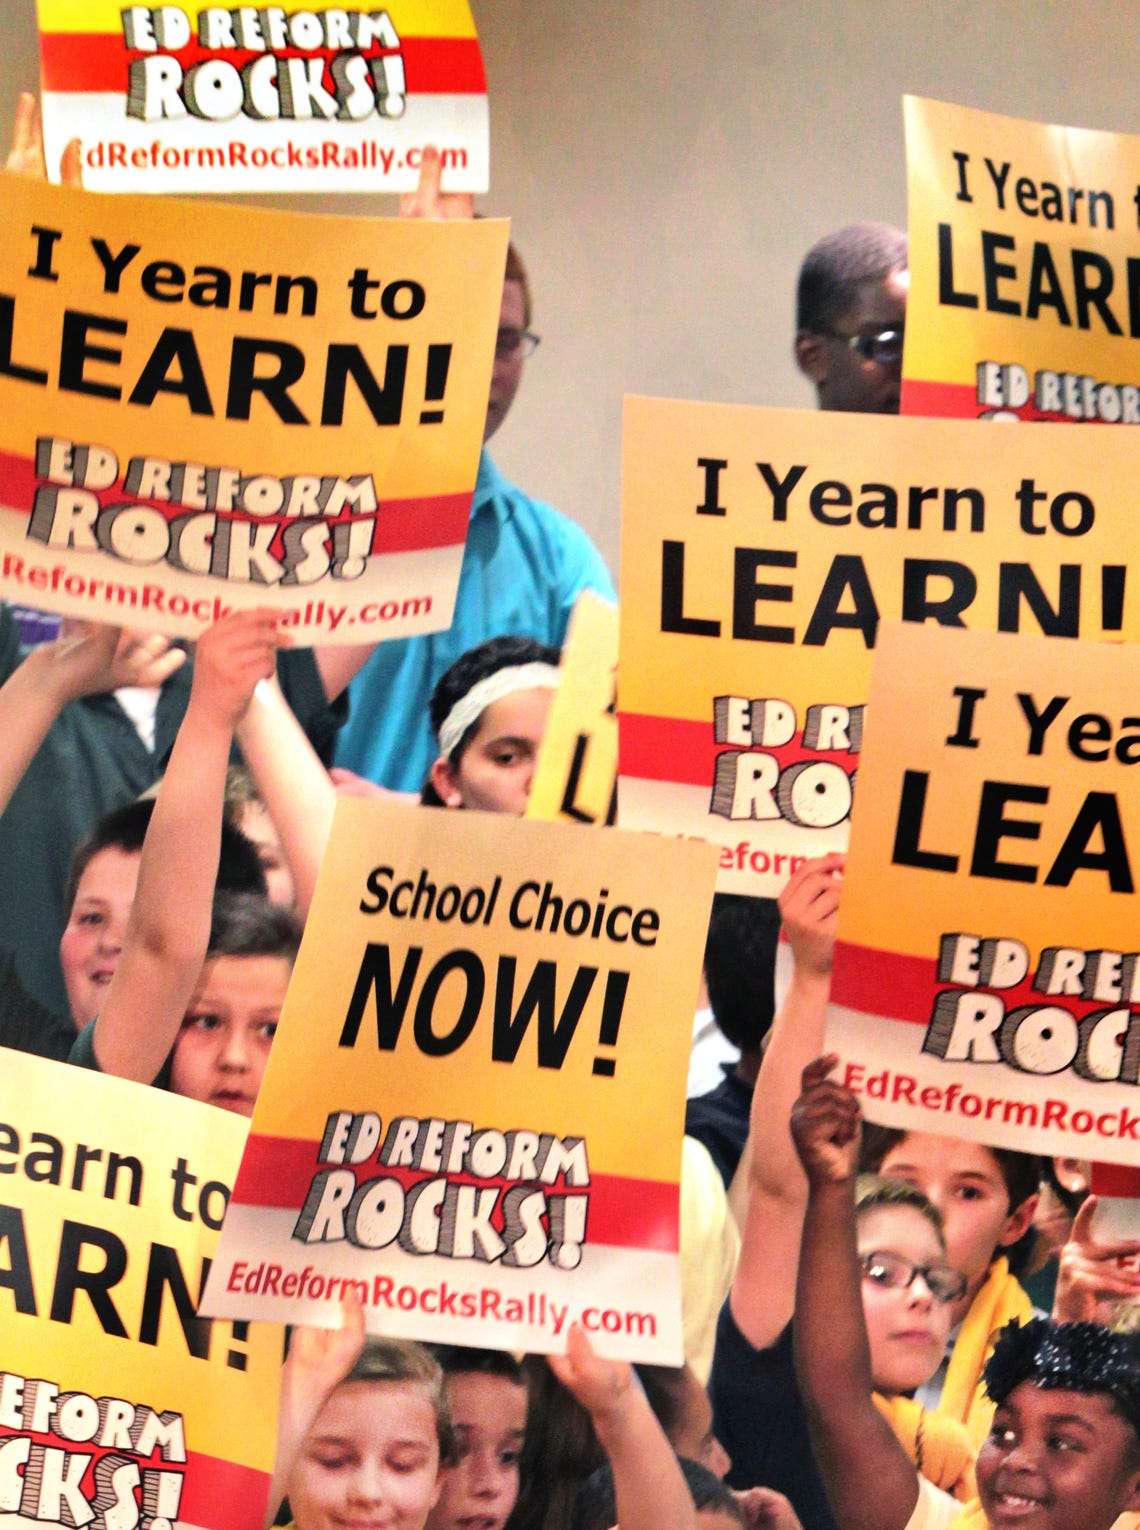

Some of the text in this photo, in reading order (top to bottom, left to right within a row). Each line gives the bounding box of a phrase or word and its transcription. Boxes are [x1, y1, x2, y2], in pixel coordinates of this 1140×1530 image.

[122, 5, 400, 51] ED REFORM
[126, 52, 407, 121] ROCKS!
[79, 138, 468, 176] dReformRocksRally.cm
[952, 151, 974, 203] I
[984, 157, 1114, 230] Yearn
[28, 224, 426, 320] I Yearn to
[0, 293, 453, 427] LEARN!
[976, 360, 1030, 409] ED
[35, 437, 378, 518] ED REFORM
[696, 458, 1095, 537] I Yearn to
[27, 486, 378, 587] ROCKS!
[660, 540, 1127, 649] LEARN!
[713, 695, 797, 748] ED
[945, 686, 986, 748] I
[360, 866, 661, 947] School Choice
[936, 933, 1030, 989] ED
[339, 942, 631, 1078] NOW!
[318, 1112, 592, 1188] ED REFORM
[171, 1157, 231, 1231] to
[292, 1169, 589, 1270] ROCKS!
[226, 1261, 658, 1336] EdReformRocksRally.com
